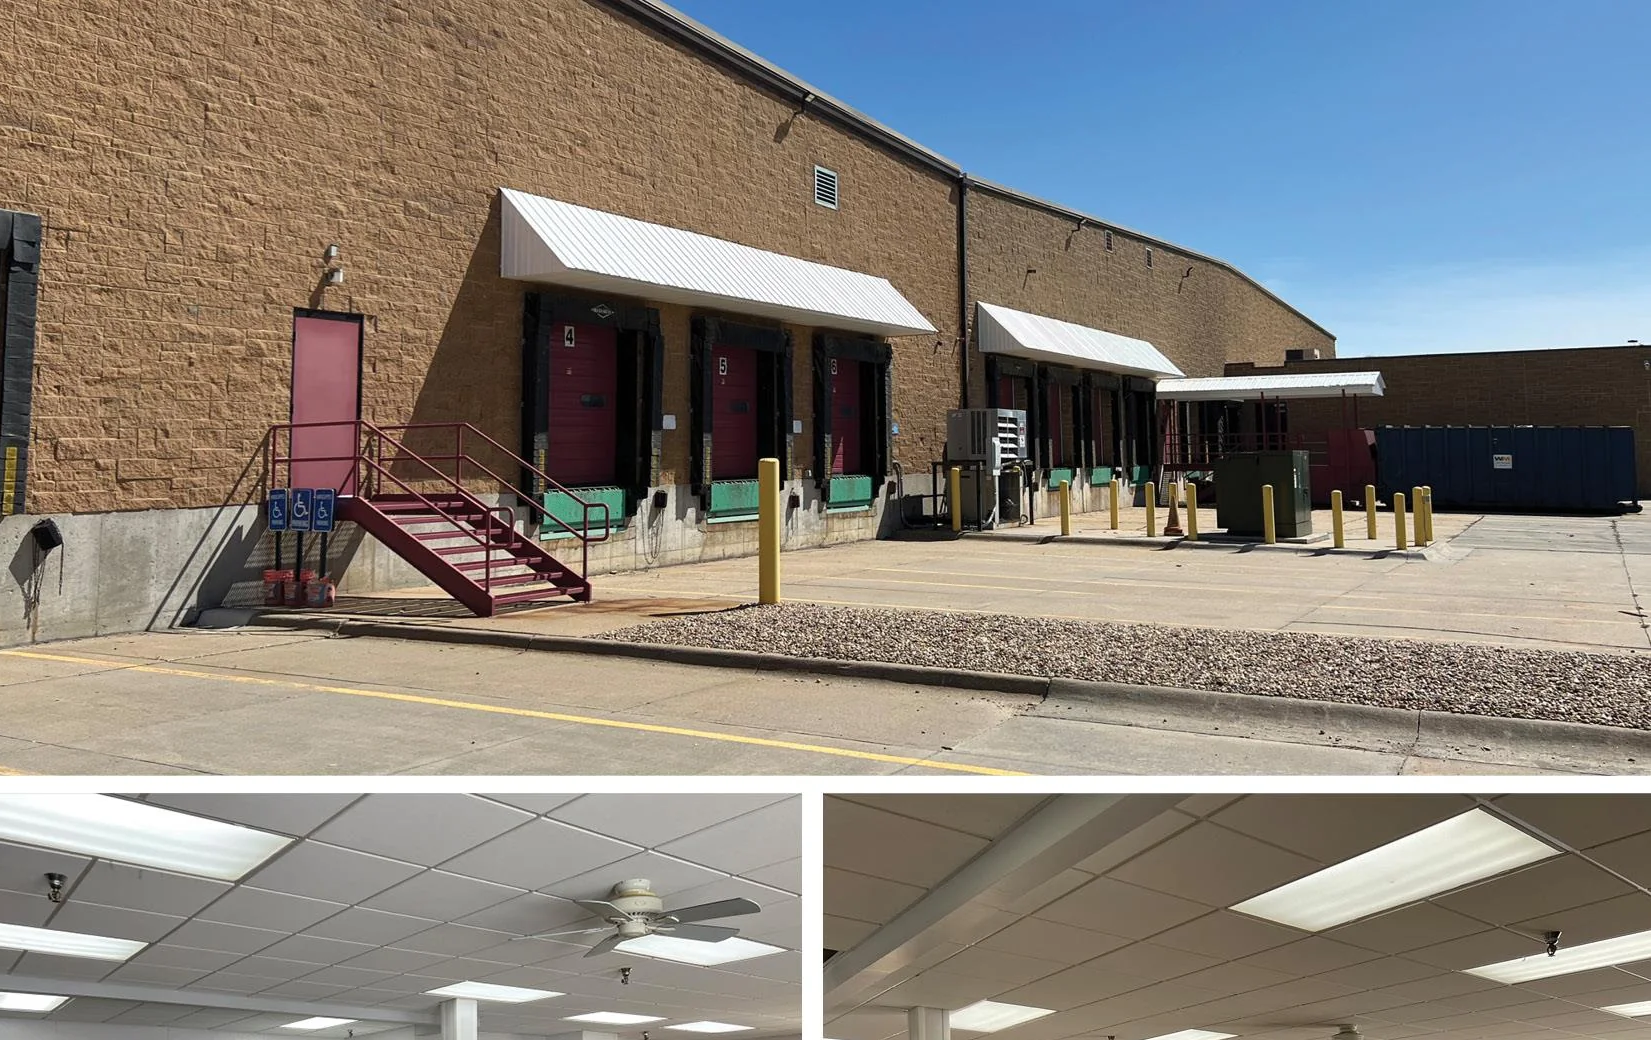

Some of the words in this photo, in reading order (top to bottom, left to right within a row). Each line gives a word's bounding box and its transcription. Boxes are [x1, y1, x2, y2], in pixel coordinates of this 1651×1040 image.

[565, 328, 574, 345] 4
[719, 359, 726, 374] 5
[831, 359, 837, 374] 6
